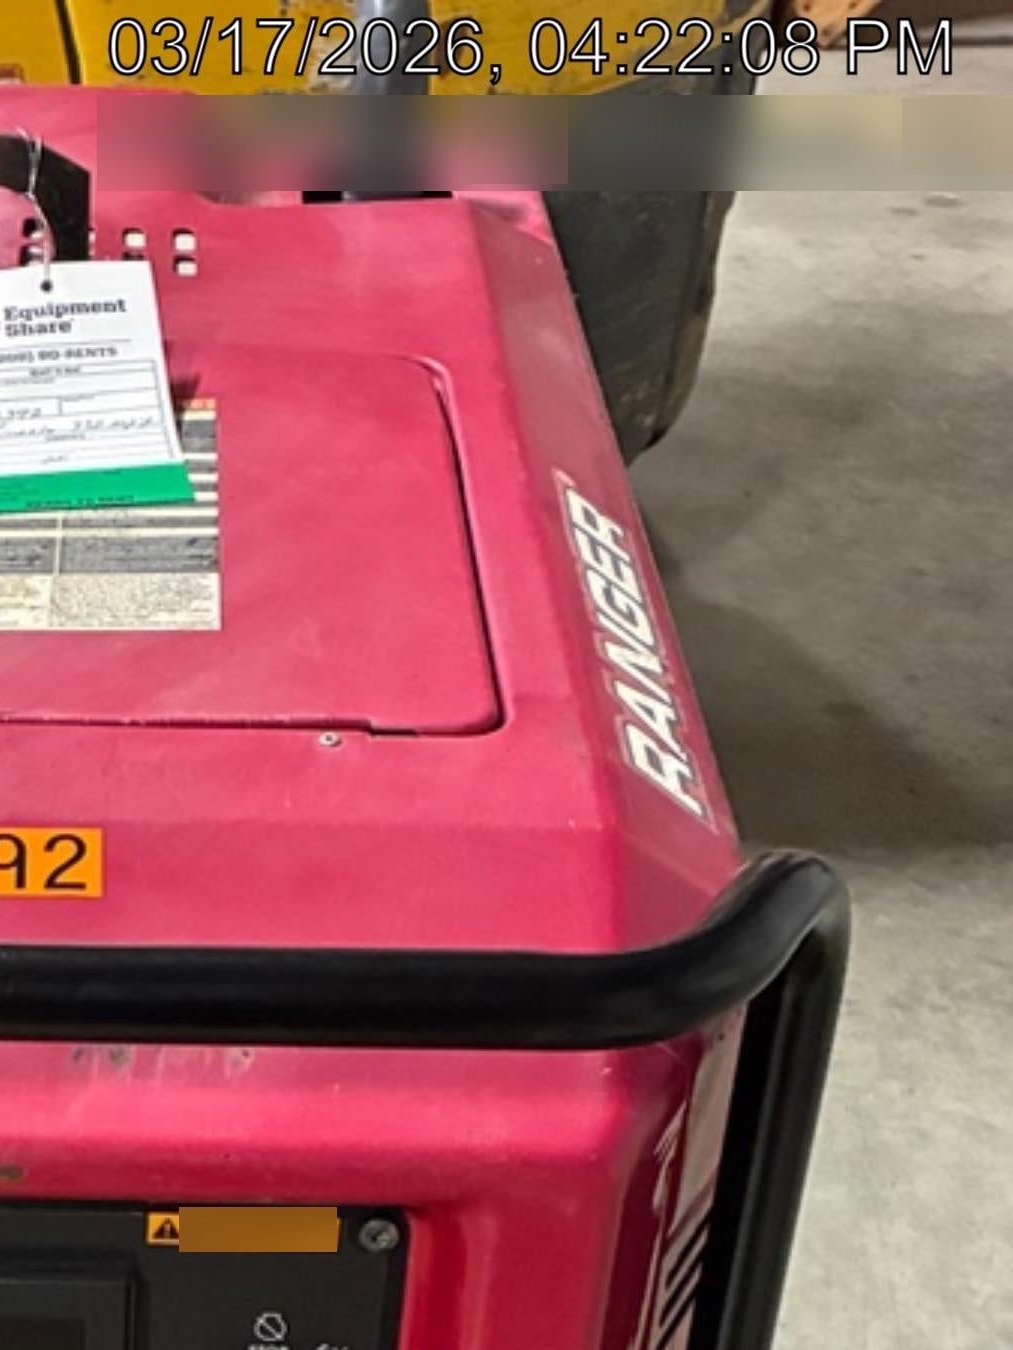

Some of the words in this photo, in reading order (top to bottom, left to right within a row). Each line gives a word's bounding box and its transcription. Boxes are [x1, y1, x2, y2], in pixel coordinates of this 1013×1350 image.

[4, 299, 127, 322] Equipment
[4, 321, 72, 338] Share
[564, 486, 705, 818] RANGER
